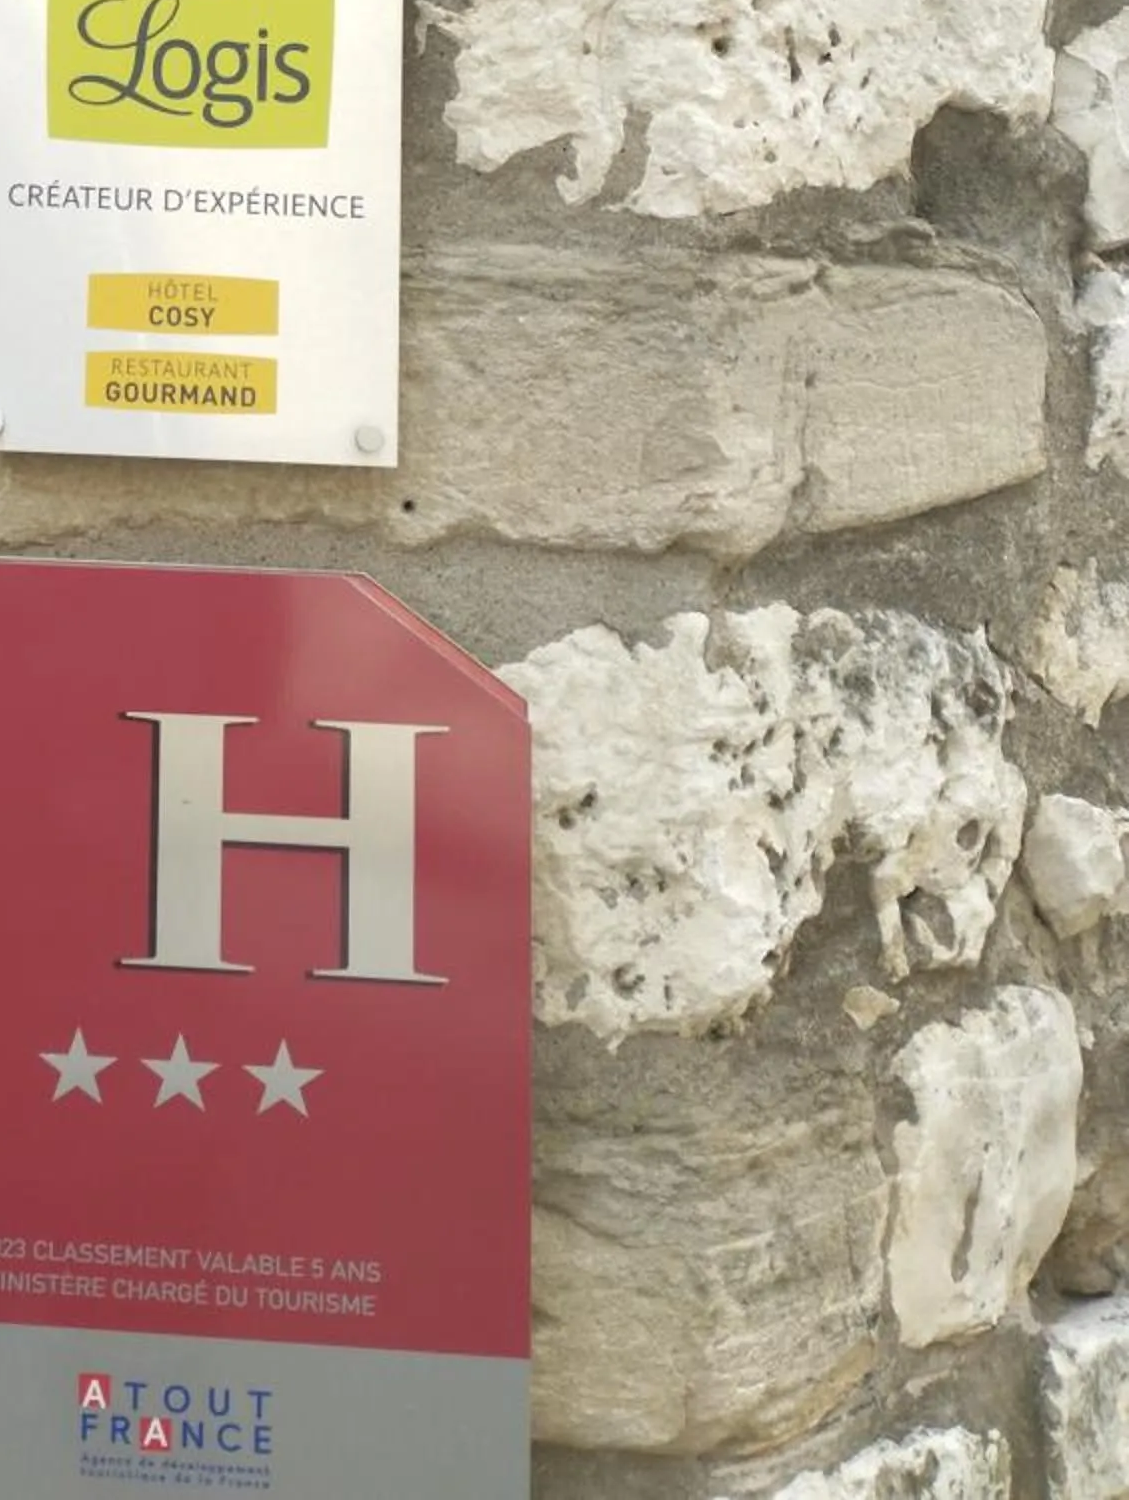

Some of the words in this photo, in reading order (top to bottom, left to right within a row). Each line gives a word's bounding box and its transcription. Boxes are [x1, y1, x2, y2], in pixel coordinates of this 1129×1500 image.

[8, 181, 152, 211] CRÉATEUR
[164, 187, 365, 219] D'EXPÉRIENCE
[148, 279, 218, 302] HÔTEL
[149, 306, 215, 328] COSY
[112, 358, 252, 380] RESTAURANT
[106, 382, 256, 407] GOURMAND
[119, 711, 450, 984] H
[33, 1240, 190, 1269] CLASSEMENT
[197, 1250, 304, 1277] VALABLE
[311, 1258, 324, 1279] 5
[331, 1260, 381, 1283] ANS
[113, 1278, 207, 1305] CHARGÉ
[216, 1286, 248, 1307] DU
[256, 1288, 376, 1316] TOURISME
[80, 1378, 273, 1420] ATOUT
[80, 1413, 273, 1454] FRANCE
[80, 1452, 131, 1467] Agence
[139, 1457, 155, 1468] de
